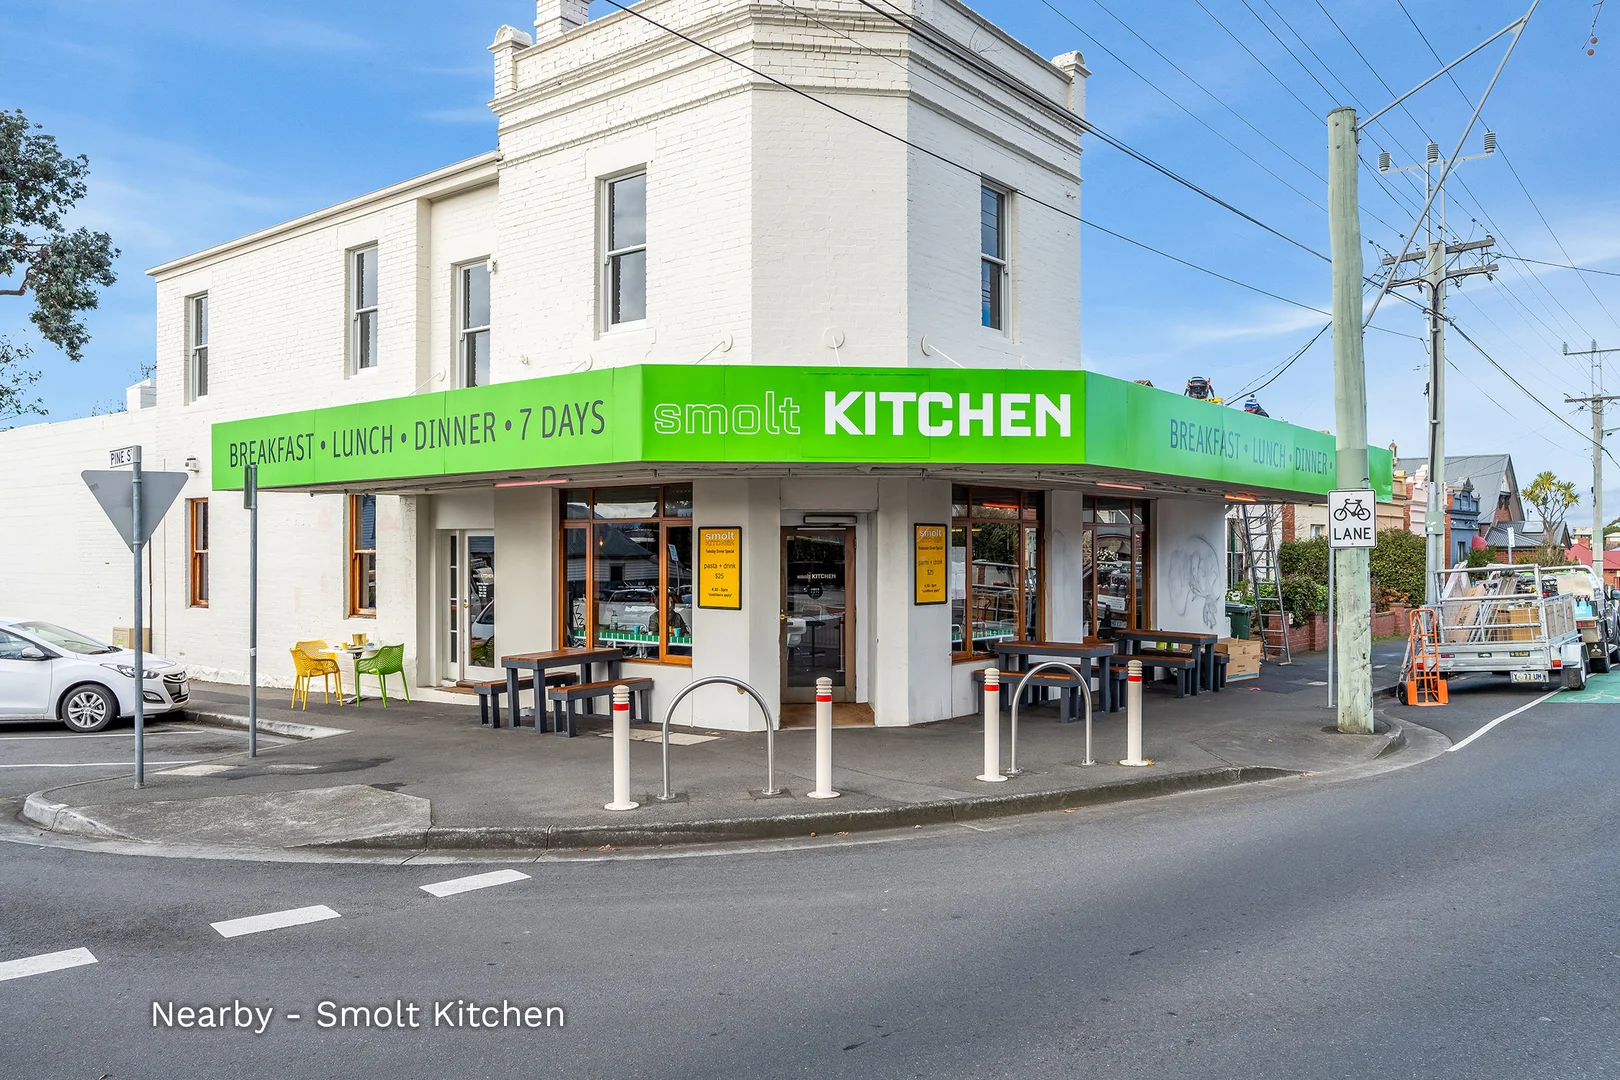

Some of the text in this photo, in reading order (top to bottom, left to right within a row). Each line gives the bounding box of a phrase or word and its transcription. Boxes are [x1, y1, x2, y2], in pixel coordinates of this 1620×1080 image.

[654, 390, 1071, 437] smolt KITCHEN
[229, 433, 314, 468] BREAKFAST
[333, 424, 393, 458] LUNCH
[415, 412, 497, 451] DINNER
[519, 408, 532, 440] 7
[541, 400, 606, 439] DAYS
[1170, 419, 1241, 460] BREAKFAST
[1252, 437, 1286, 469] LUNCH
[1295, 446, 1328, 476] DINNER
[111, 452, 124, 465] PINE
[705, 532, 734, 540] smolt
[1334, 527, 1371, 540] LANE
